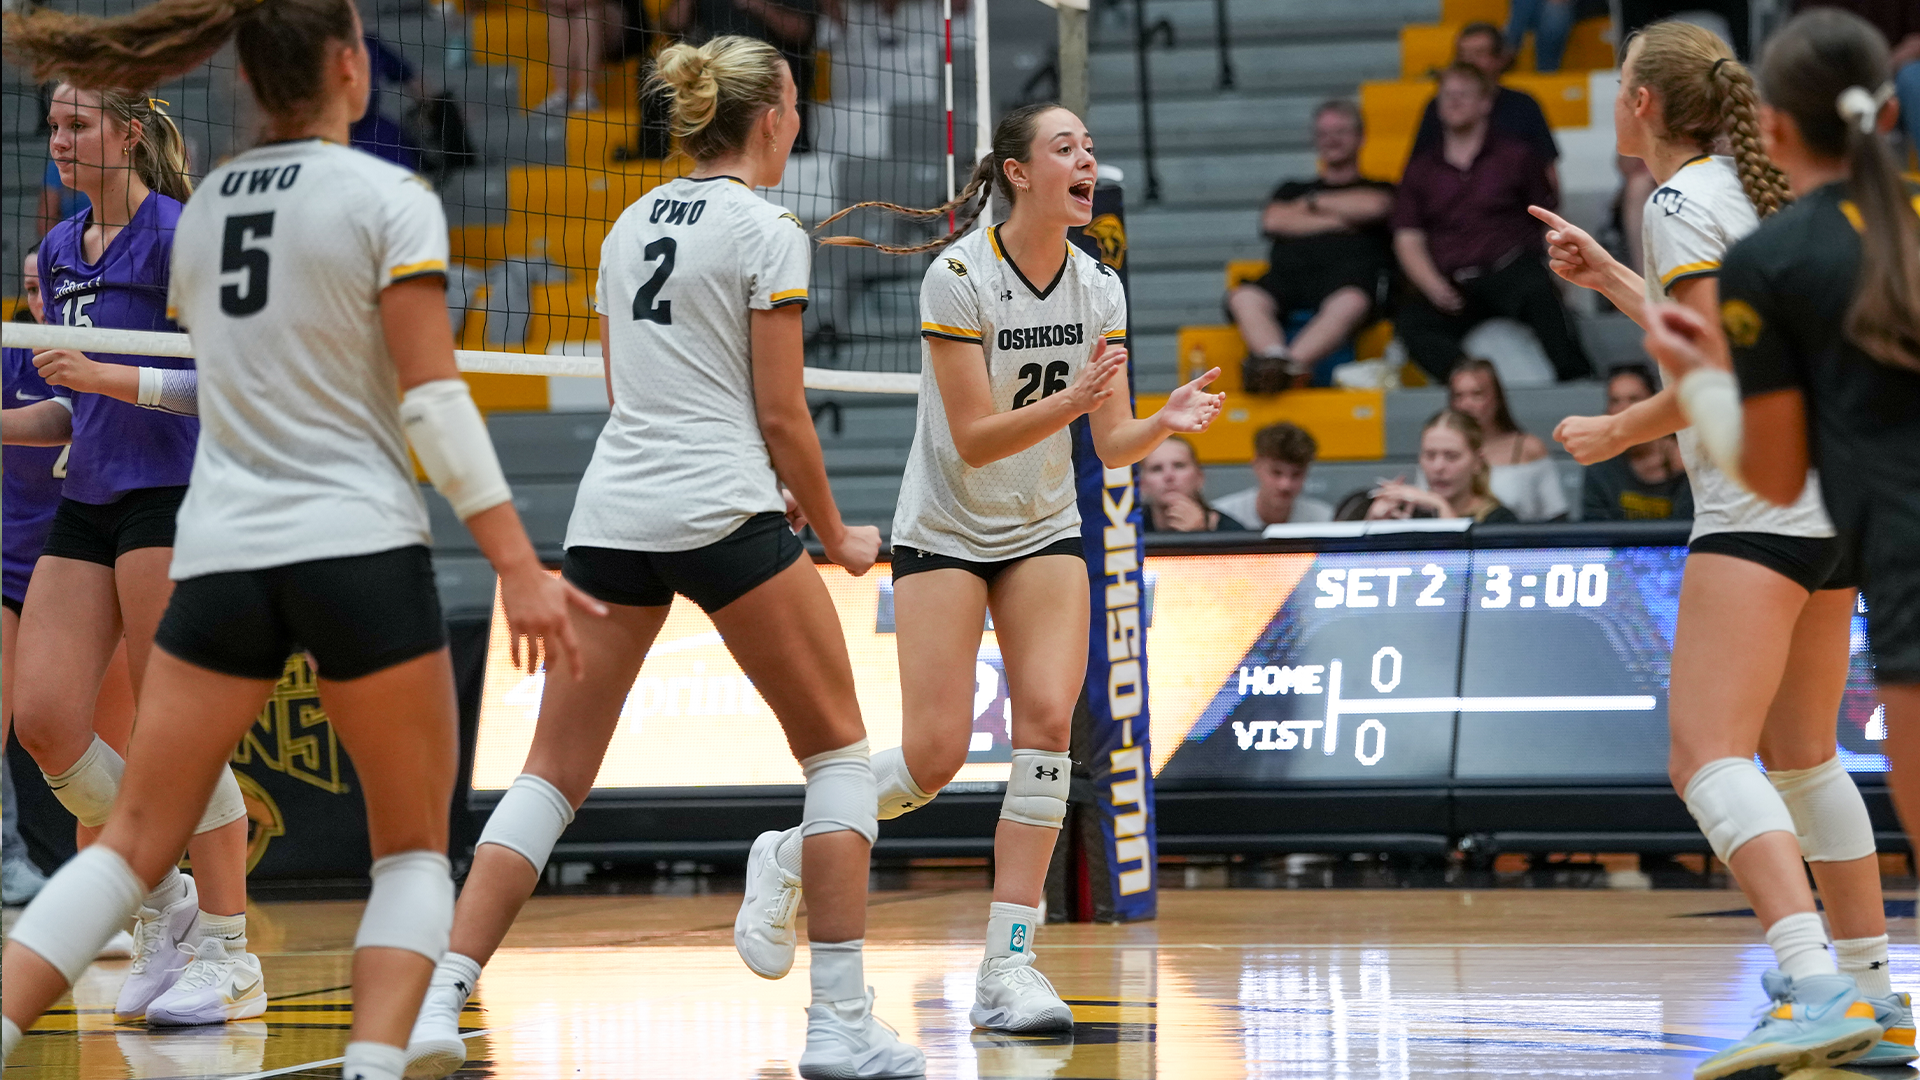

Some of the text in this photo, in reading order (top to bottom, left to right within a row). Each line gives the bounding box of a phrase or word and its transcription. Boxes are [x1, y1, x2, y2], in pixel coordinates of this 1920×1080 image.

[220, 163, 301, 196] UWO
[649, 198, 707, 226] UWO
[219, 210, 275, 318] 5
[632, 236, 677, 326] 2
[62, 294, 96, 328] 15
[1011, 360, 1070, 411] 26
[1315, 563, 1447, 608] SET 2
[1481, 563, 1609, 608] 3:00
[1238, 646, 1402, 695] HOME 0
[1231, 719, 1386, 766] VIST 0
